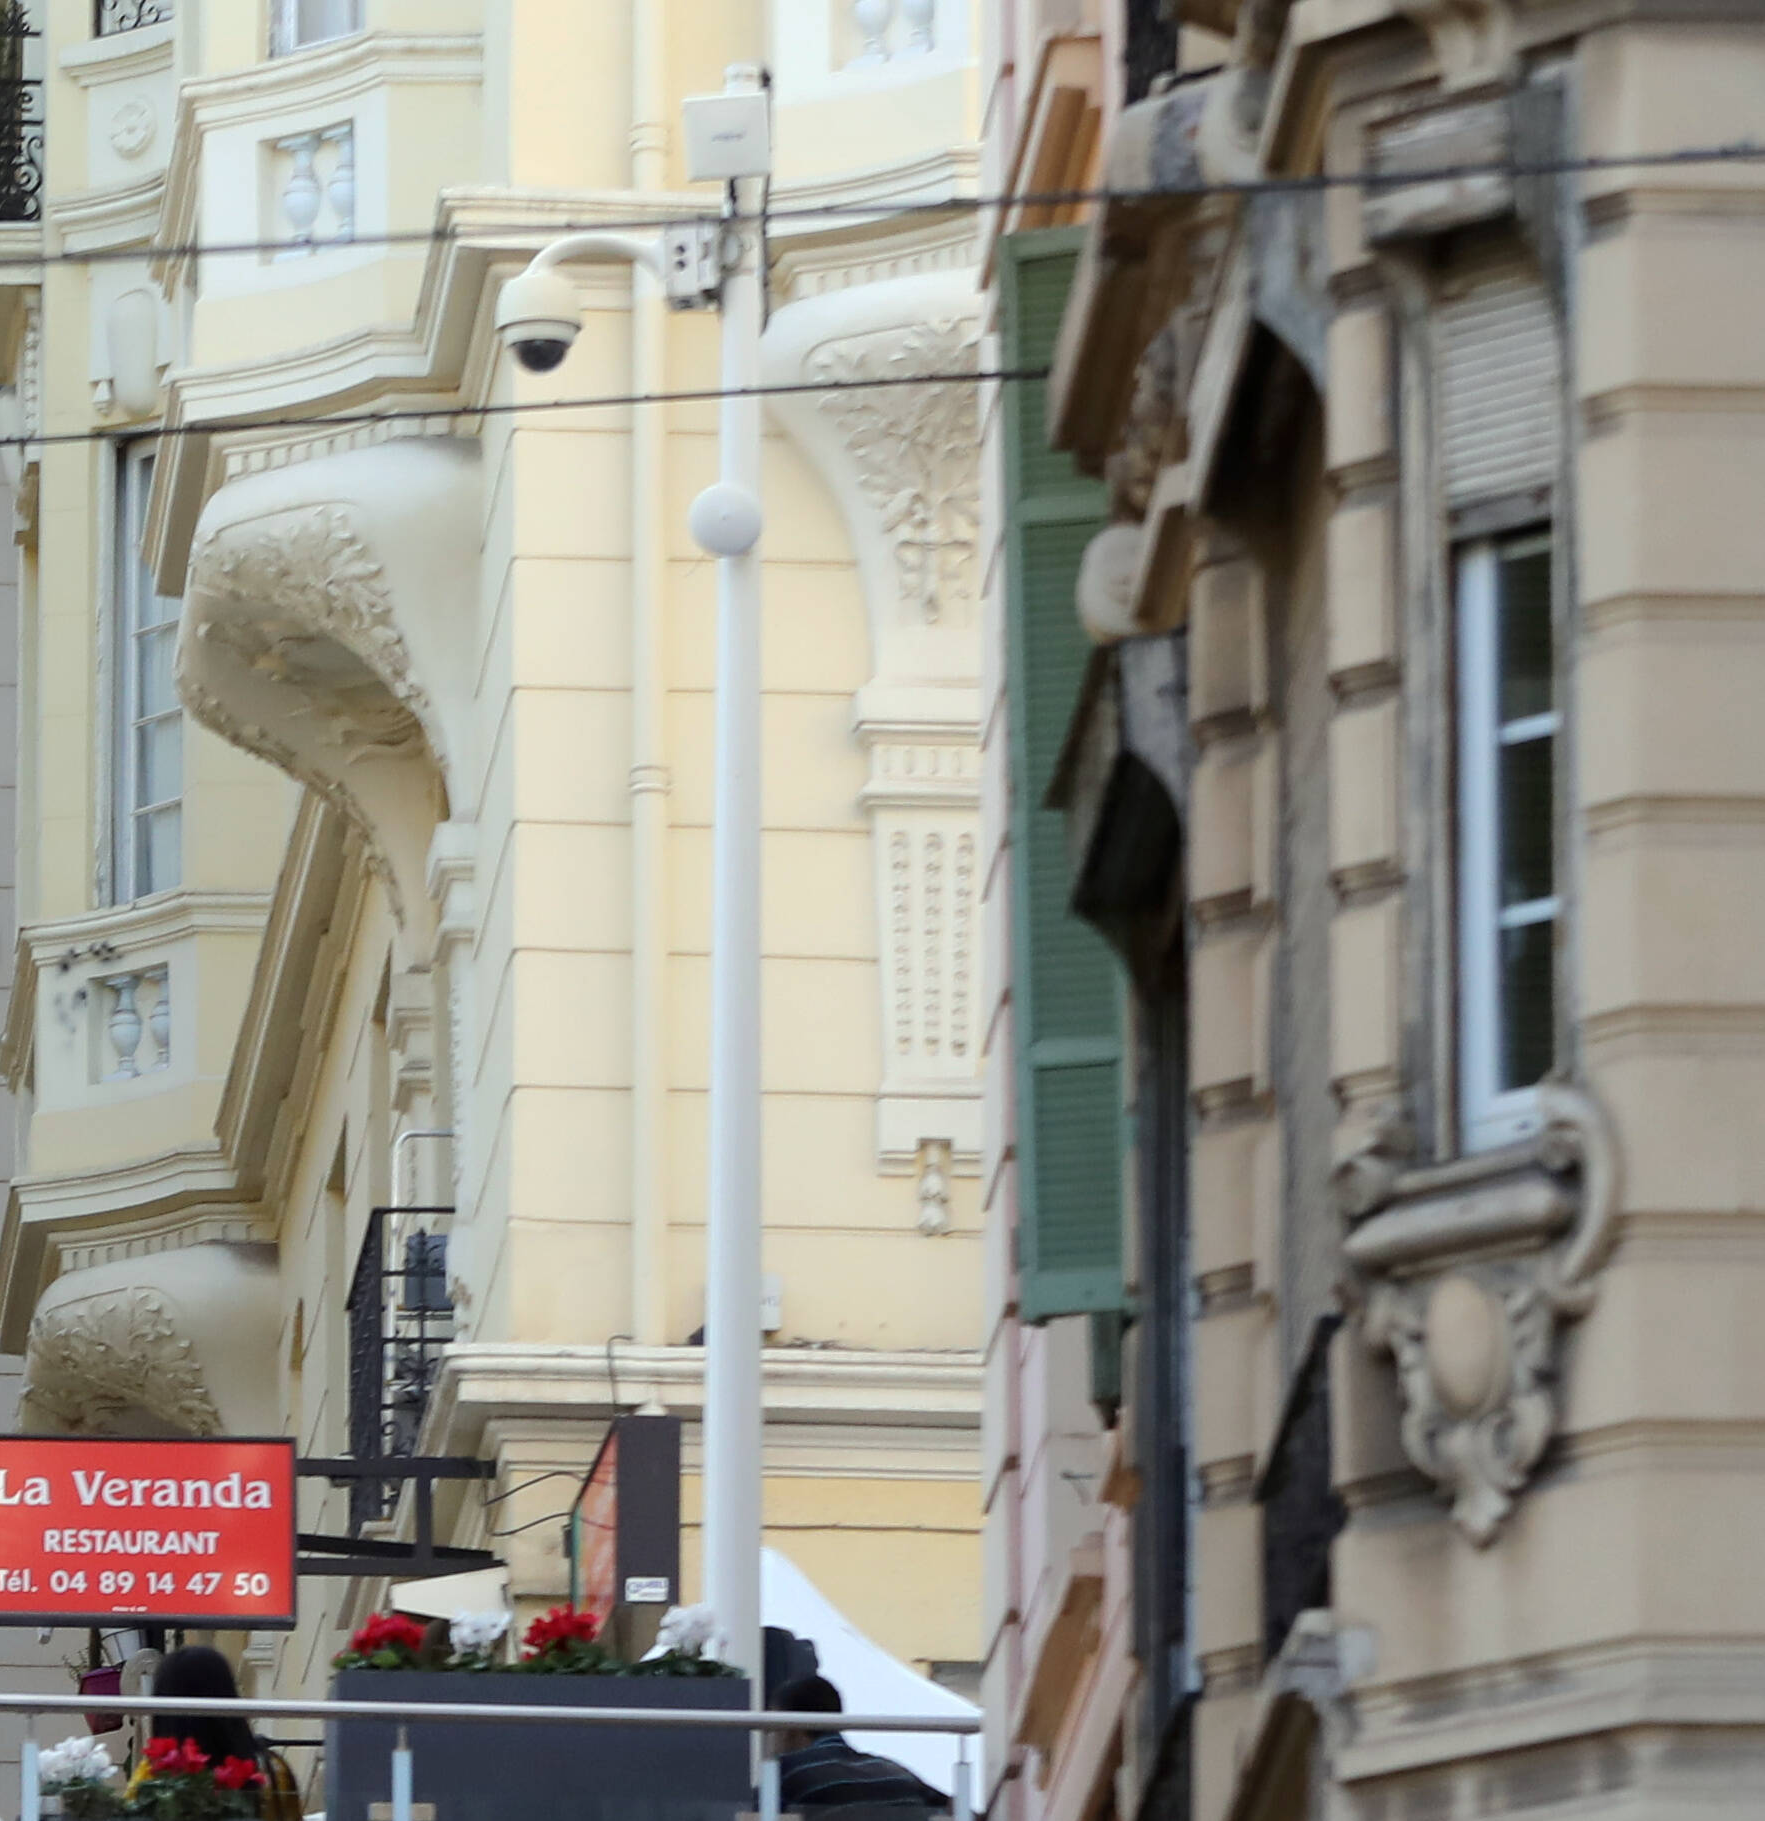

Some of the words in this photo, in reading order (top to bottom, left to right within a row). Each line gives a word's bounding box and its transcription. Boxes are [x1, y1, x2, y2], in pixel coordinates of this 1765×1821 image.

[71, 1470, 272, 1509] Veranda
[42, 1529, 220, 1555] RESTAURANT
[50, 1570, 88, 1594] 04
[99, 1570, 135, 1595] 89
[146, 1571, 175, 1595] 14
[185, 1572, 223, 1595] 47
[232, 1572, 270, 1596] 50
